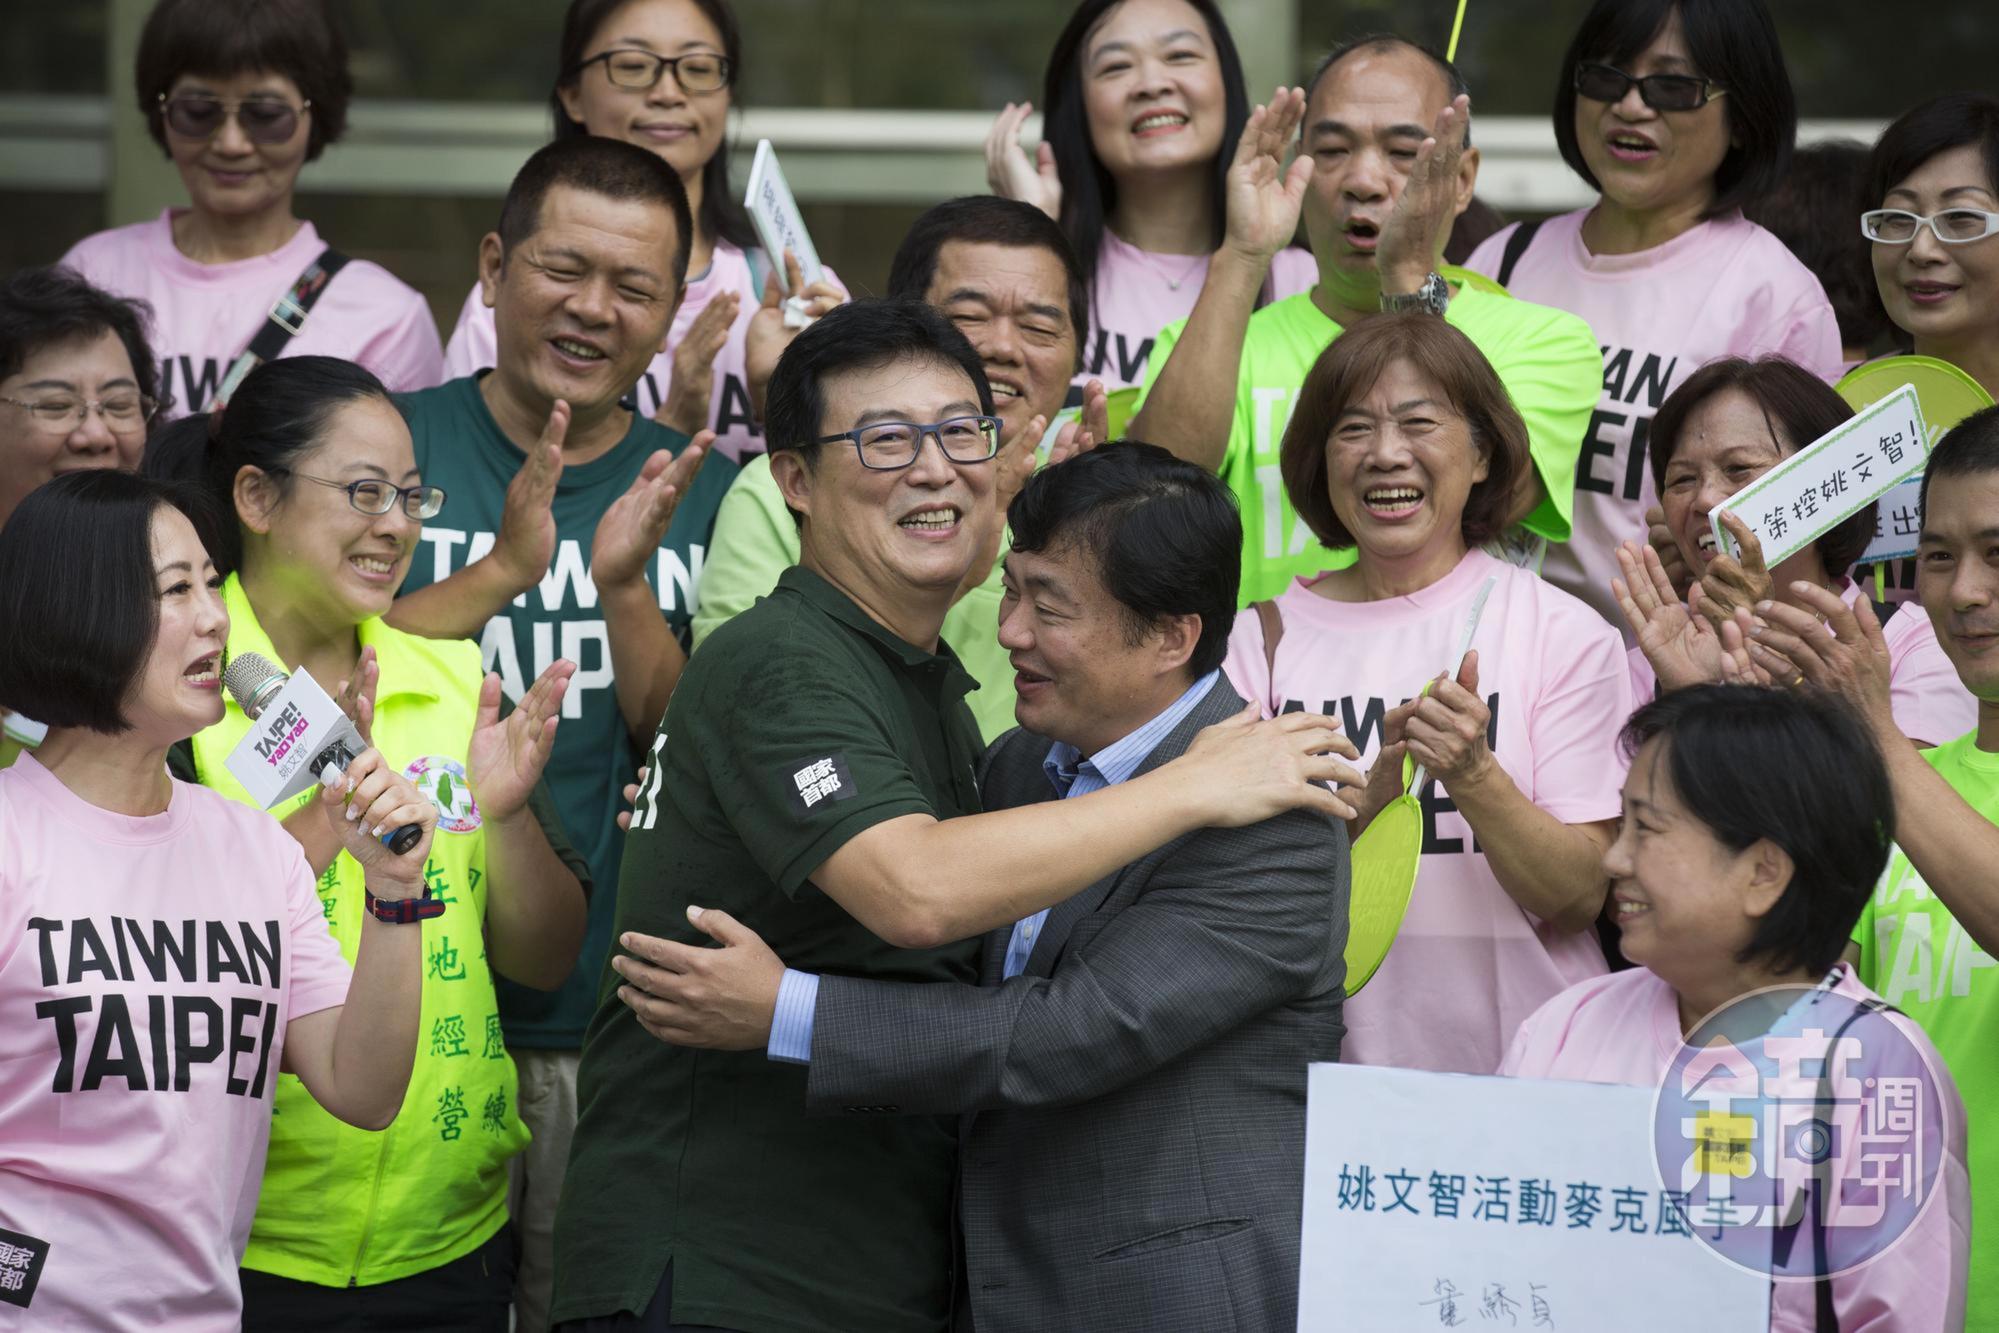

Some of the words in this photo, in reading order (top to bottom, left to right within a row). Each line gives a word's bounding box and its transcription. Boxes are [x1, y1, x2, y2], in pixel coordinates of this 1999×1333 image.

[1732, 419, 1919, 561] 策控姚文智!
[793, 757, 836, 791] 國家
[800, 773, 842, 808] 首都
[27, 915, 281, 990] TAIWAN
[35, 993, 278, 1099] TAIPEI
[1337, 1163, 1741, 1242] 姚文智活動麥克風手
